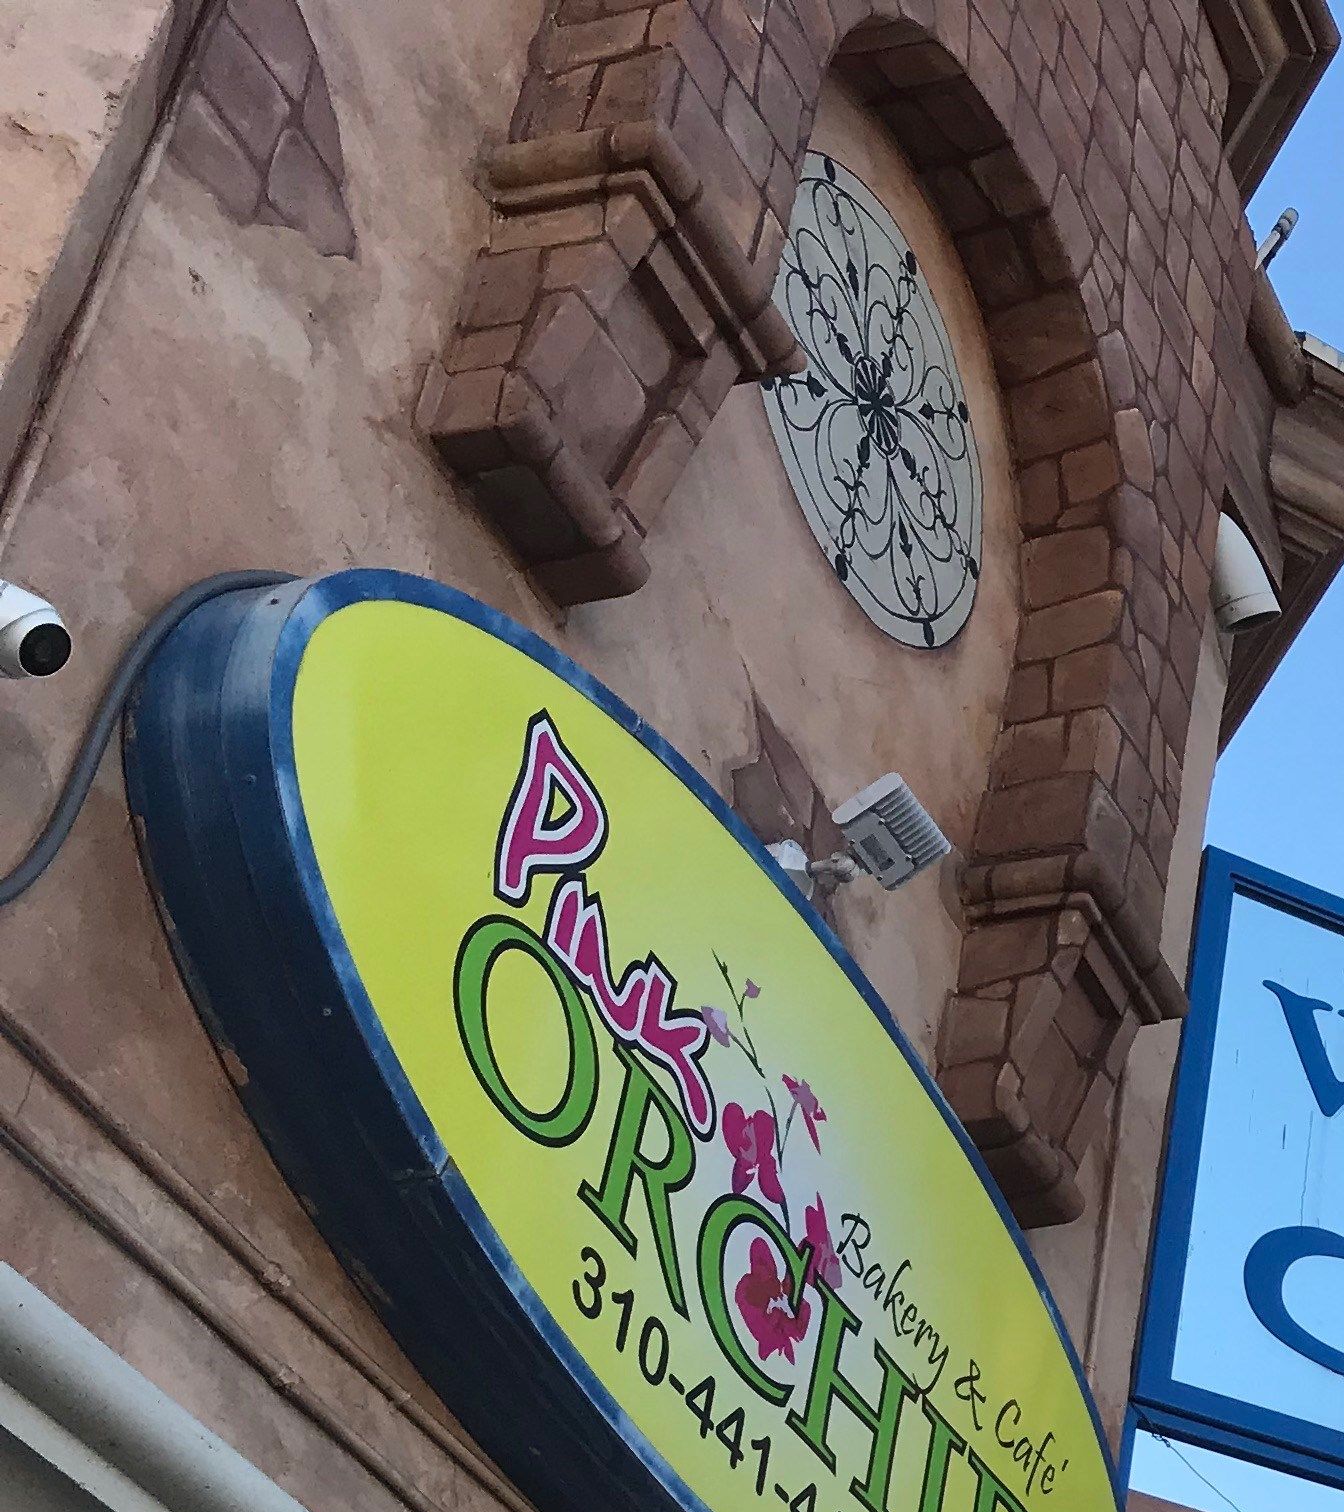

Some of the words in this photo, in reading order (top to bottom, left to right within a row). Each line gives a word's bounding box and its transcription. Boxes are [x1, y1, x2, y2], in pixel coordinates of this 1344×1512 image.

[494, 707, 717, 1142] Pink
[837, 1212, 950, 1395] Bakery
[954, 1358, 987, 1432] &
